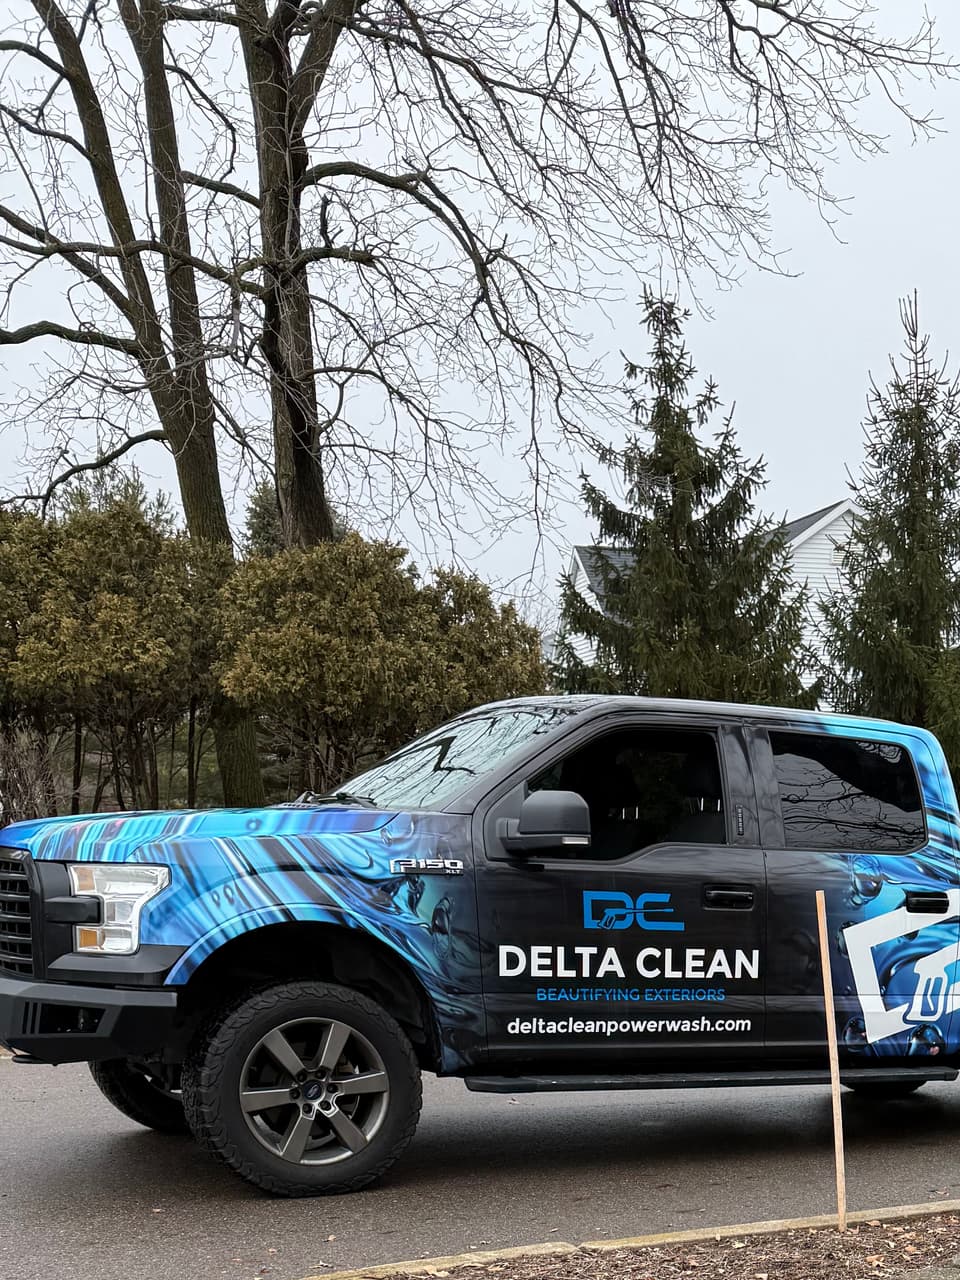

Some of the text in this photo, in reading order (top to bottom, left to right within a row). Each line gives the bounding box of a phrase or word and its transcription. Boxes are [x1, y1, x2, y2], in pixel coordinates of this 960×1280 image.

[498, 945, 760, 979] DELTA CLEAN
[536, 987, 726, 1002] BEAUTIFYING EXTERIORS
[507, 1016, 752, 1037] deltacleanpowerwash.com
